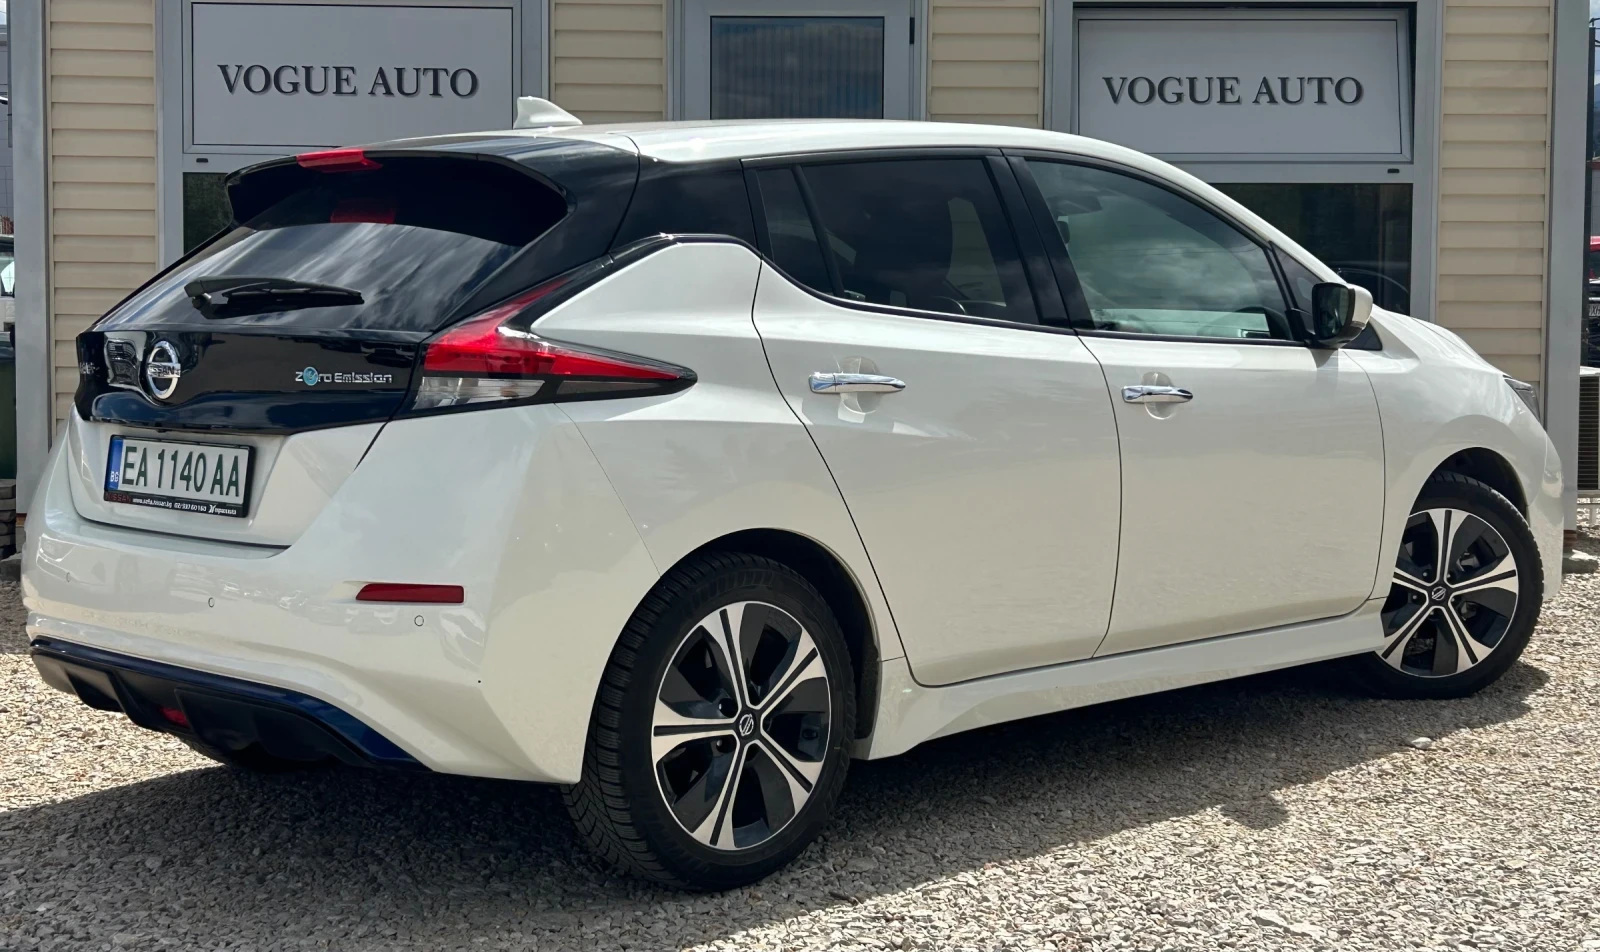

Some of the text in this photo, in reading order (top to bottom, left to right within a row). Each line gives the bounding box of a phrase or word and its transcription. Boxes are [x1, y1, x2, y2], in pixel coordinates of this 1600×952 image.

[217, 64, 479, 98] VOGUE AUTO
[1102, 76, 1364, 105] VOGUE AUTO
[334, 372, 392, 383] Emission
[110, 471, 120, 483] BG
[122, 446, 239, 497] EA 1140 AA
